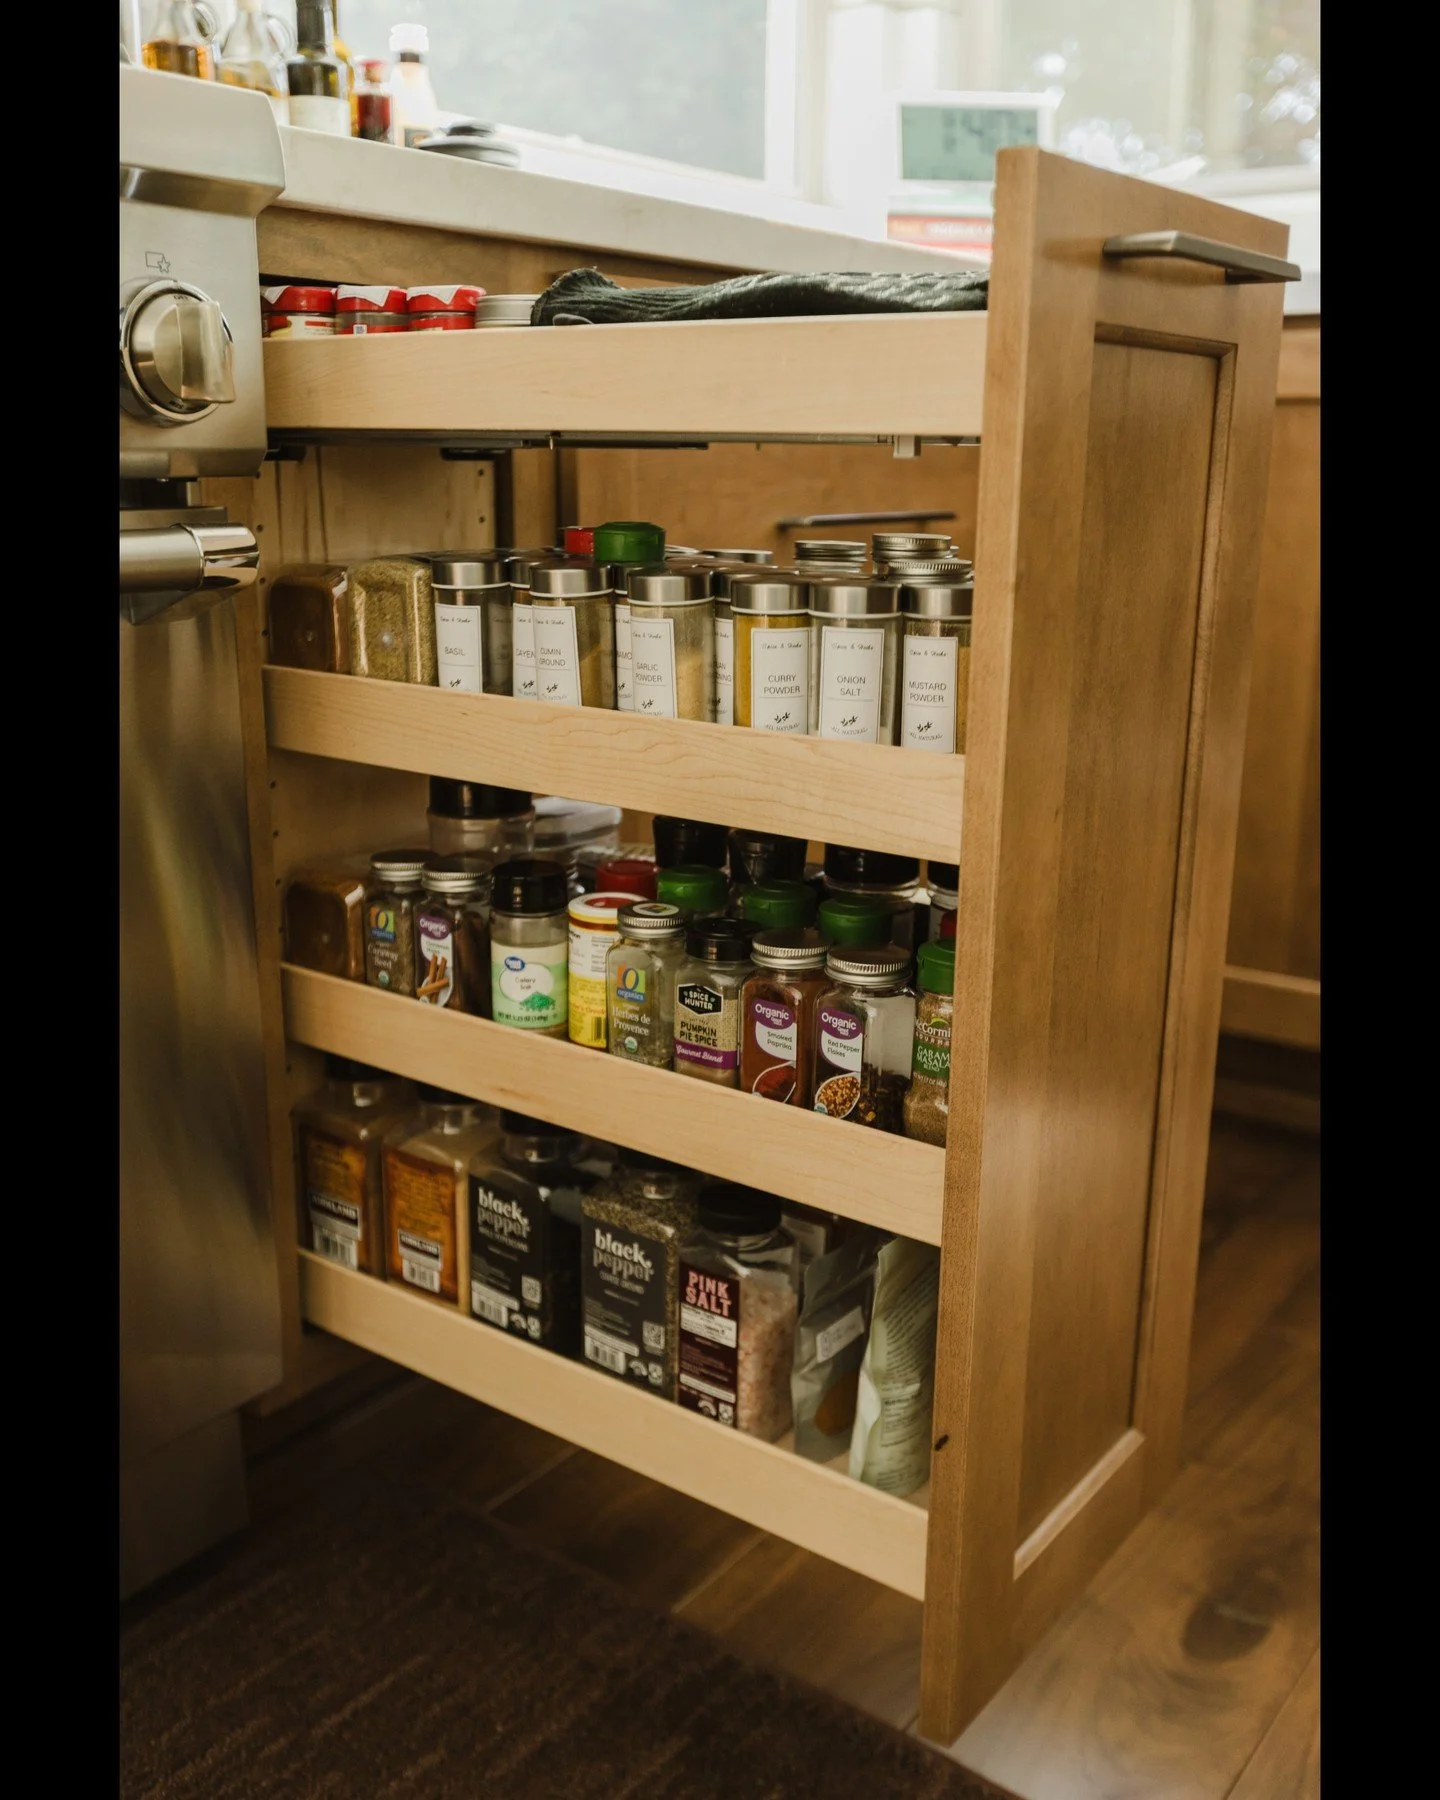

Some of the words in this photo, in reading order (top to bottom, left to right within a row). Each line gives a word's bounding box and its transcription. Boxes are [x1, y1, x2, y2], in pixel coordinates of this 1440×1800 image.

[444, 646, 465, 656] BASIL
[539, 658, 566, 667] GROUND
[637, 662, 659, 671] GARLIC
[635, 672, 663, 683] POWDER
[768, 674, 797, 683] CURRY
[837, 675, 866, 685] ONION
[763, 685, 801, 694] POWDER
[839, 688, 861, 697] SALT
[908, 681, 947, 691] MUSTARD
[909, 693, 945, 703] POWDER
[419, 917, 447, 933] Organic
[617, 988, 644, 1002] organics
[688, 990, 710, 1002] SPICE
[684, 997, 713, 1011] HUNTER
[755, 1003, 790, 1020] Organic
[612, 1006, 639, 1023] Herbes
[640, 1014, 651, 1025] de
[821, 1012, 857, 1031] Organic
[613, 1018, 650, 1036] Provence
[680, 1021, 717, 1038] PUMPKIN
[915, 1018, 951, 1038] cCormi
[680, 1030, 693, 1042] PIE
[694, 1034, 718, 1048] SPICE
[767, 1031, 793, 1043] Smoked
[767, 1039, 793, 1051] Paprika
[827, 1039, 839, 1048] Red
[839, 1043, 861, 1054] Pepper
[827, 1047, 846, 1058] Flakes
[676, 1043, 702, 1059] Gourmet
[701, 1051, 724, 1064] Blend
[916, 1052, 951, 1069] MASALA
[917, 1045, 950, 1061] GARAM
[478, 1186, 530, 1226] black
[477, 1206, 531, 1240] pepper
[594, 1228, 653, 1269] black
[592, 1247, 655, 1283] pepper
[687, 1269, 730, 1299] PINK
[685, 1285, 732, 1318] SALT
